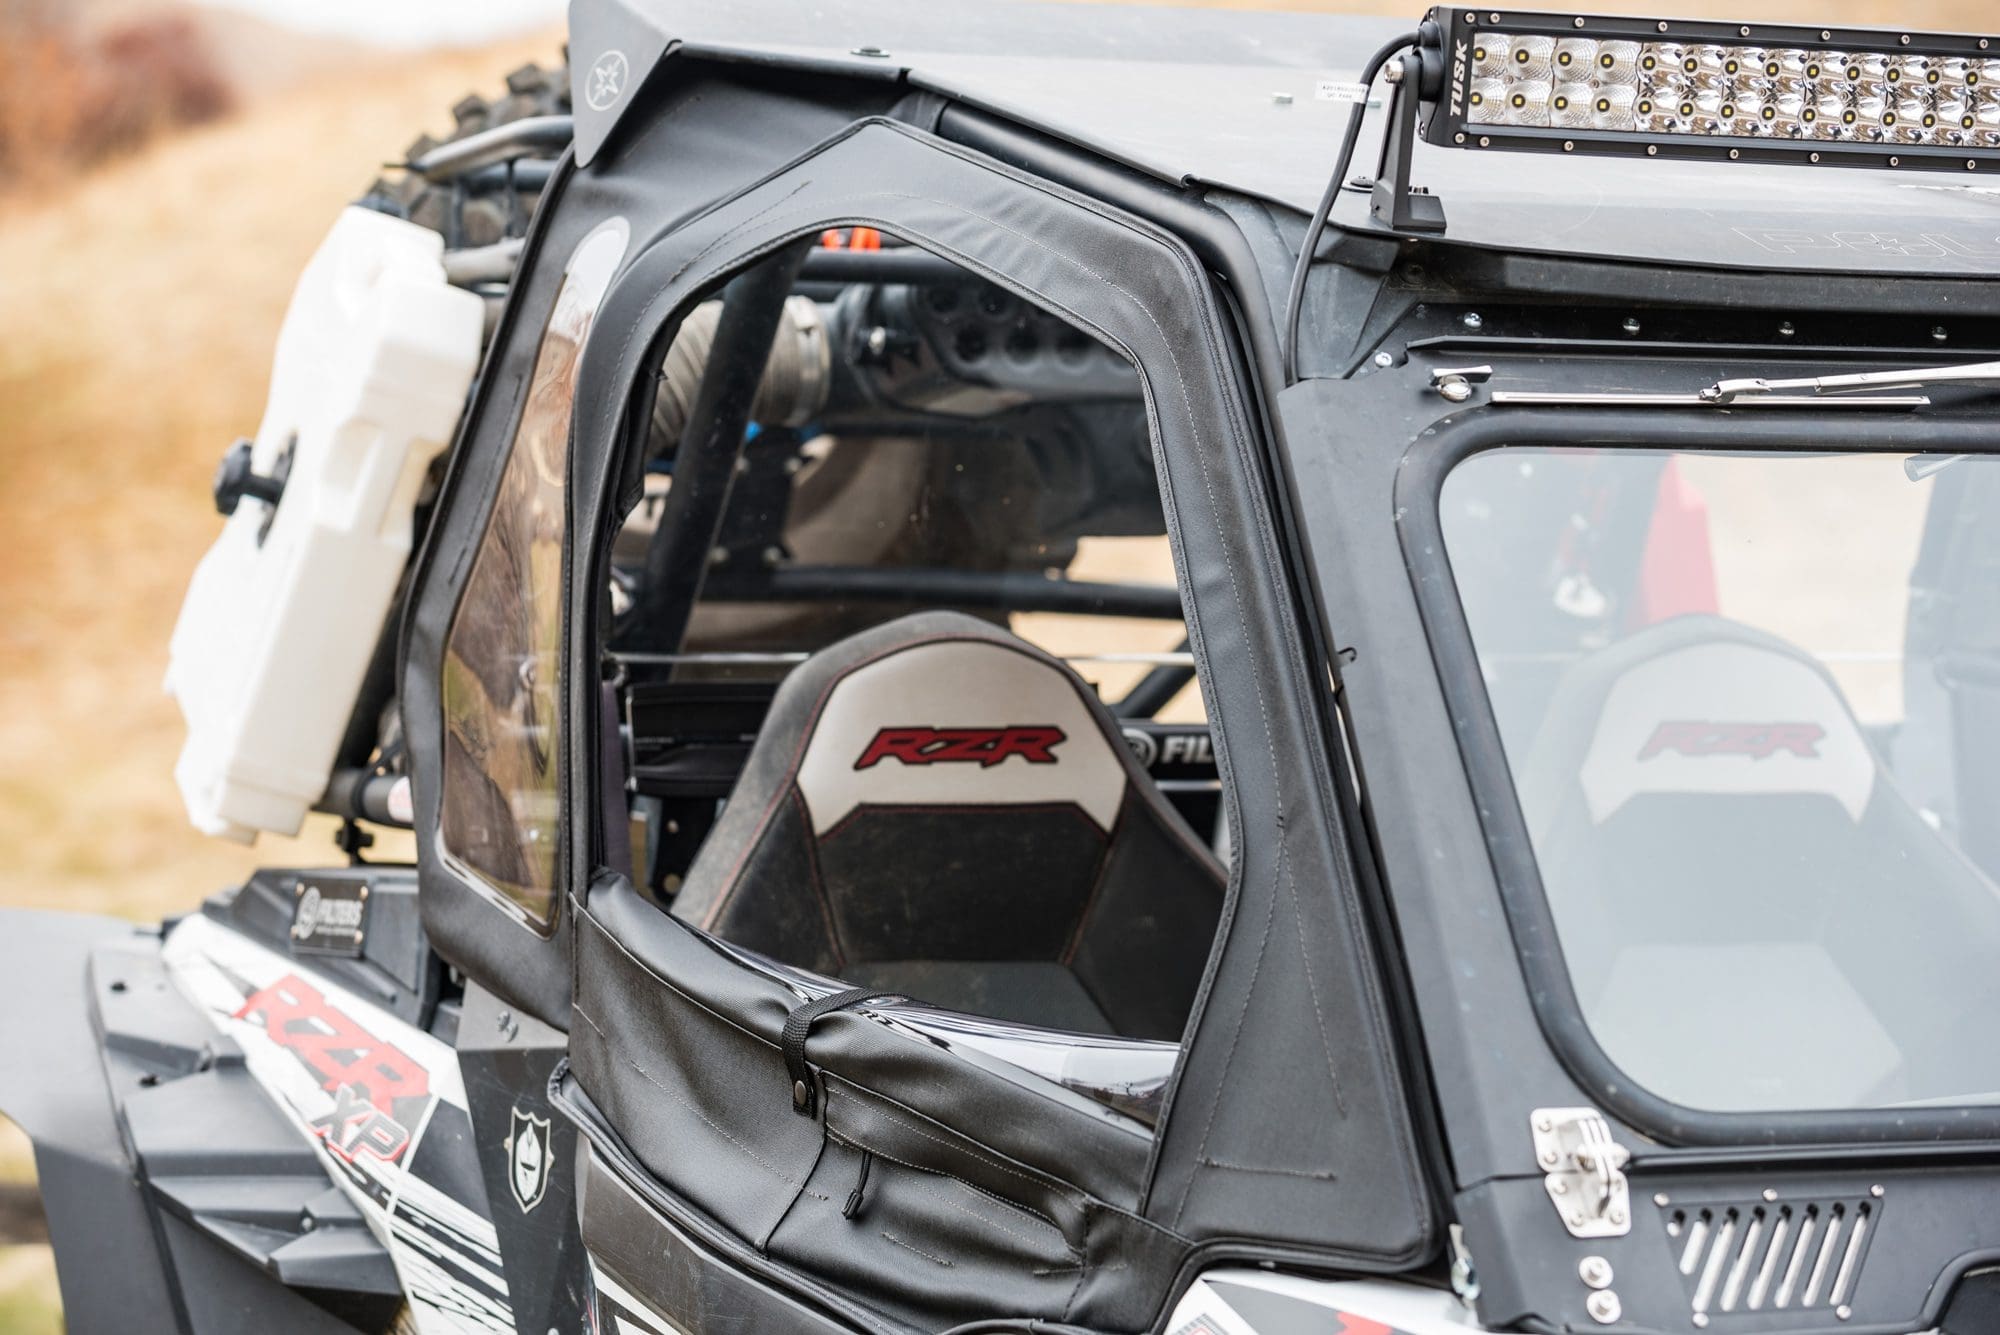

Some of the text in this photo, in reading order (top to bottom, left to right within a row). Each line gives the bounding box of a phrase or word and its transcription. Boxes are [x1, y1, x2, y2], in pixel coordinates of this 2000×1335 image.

[1450, 39, 1468, 117] TUSK
[852, 725, 1068, 771] RZR
[1636, 720, 1827, 763] RZR
[231, 973, 430, 1119] RZR
[308, 1082, 411, 1163] XP
